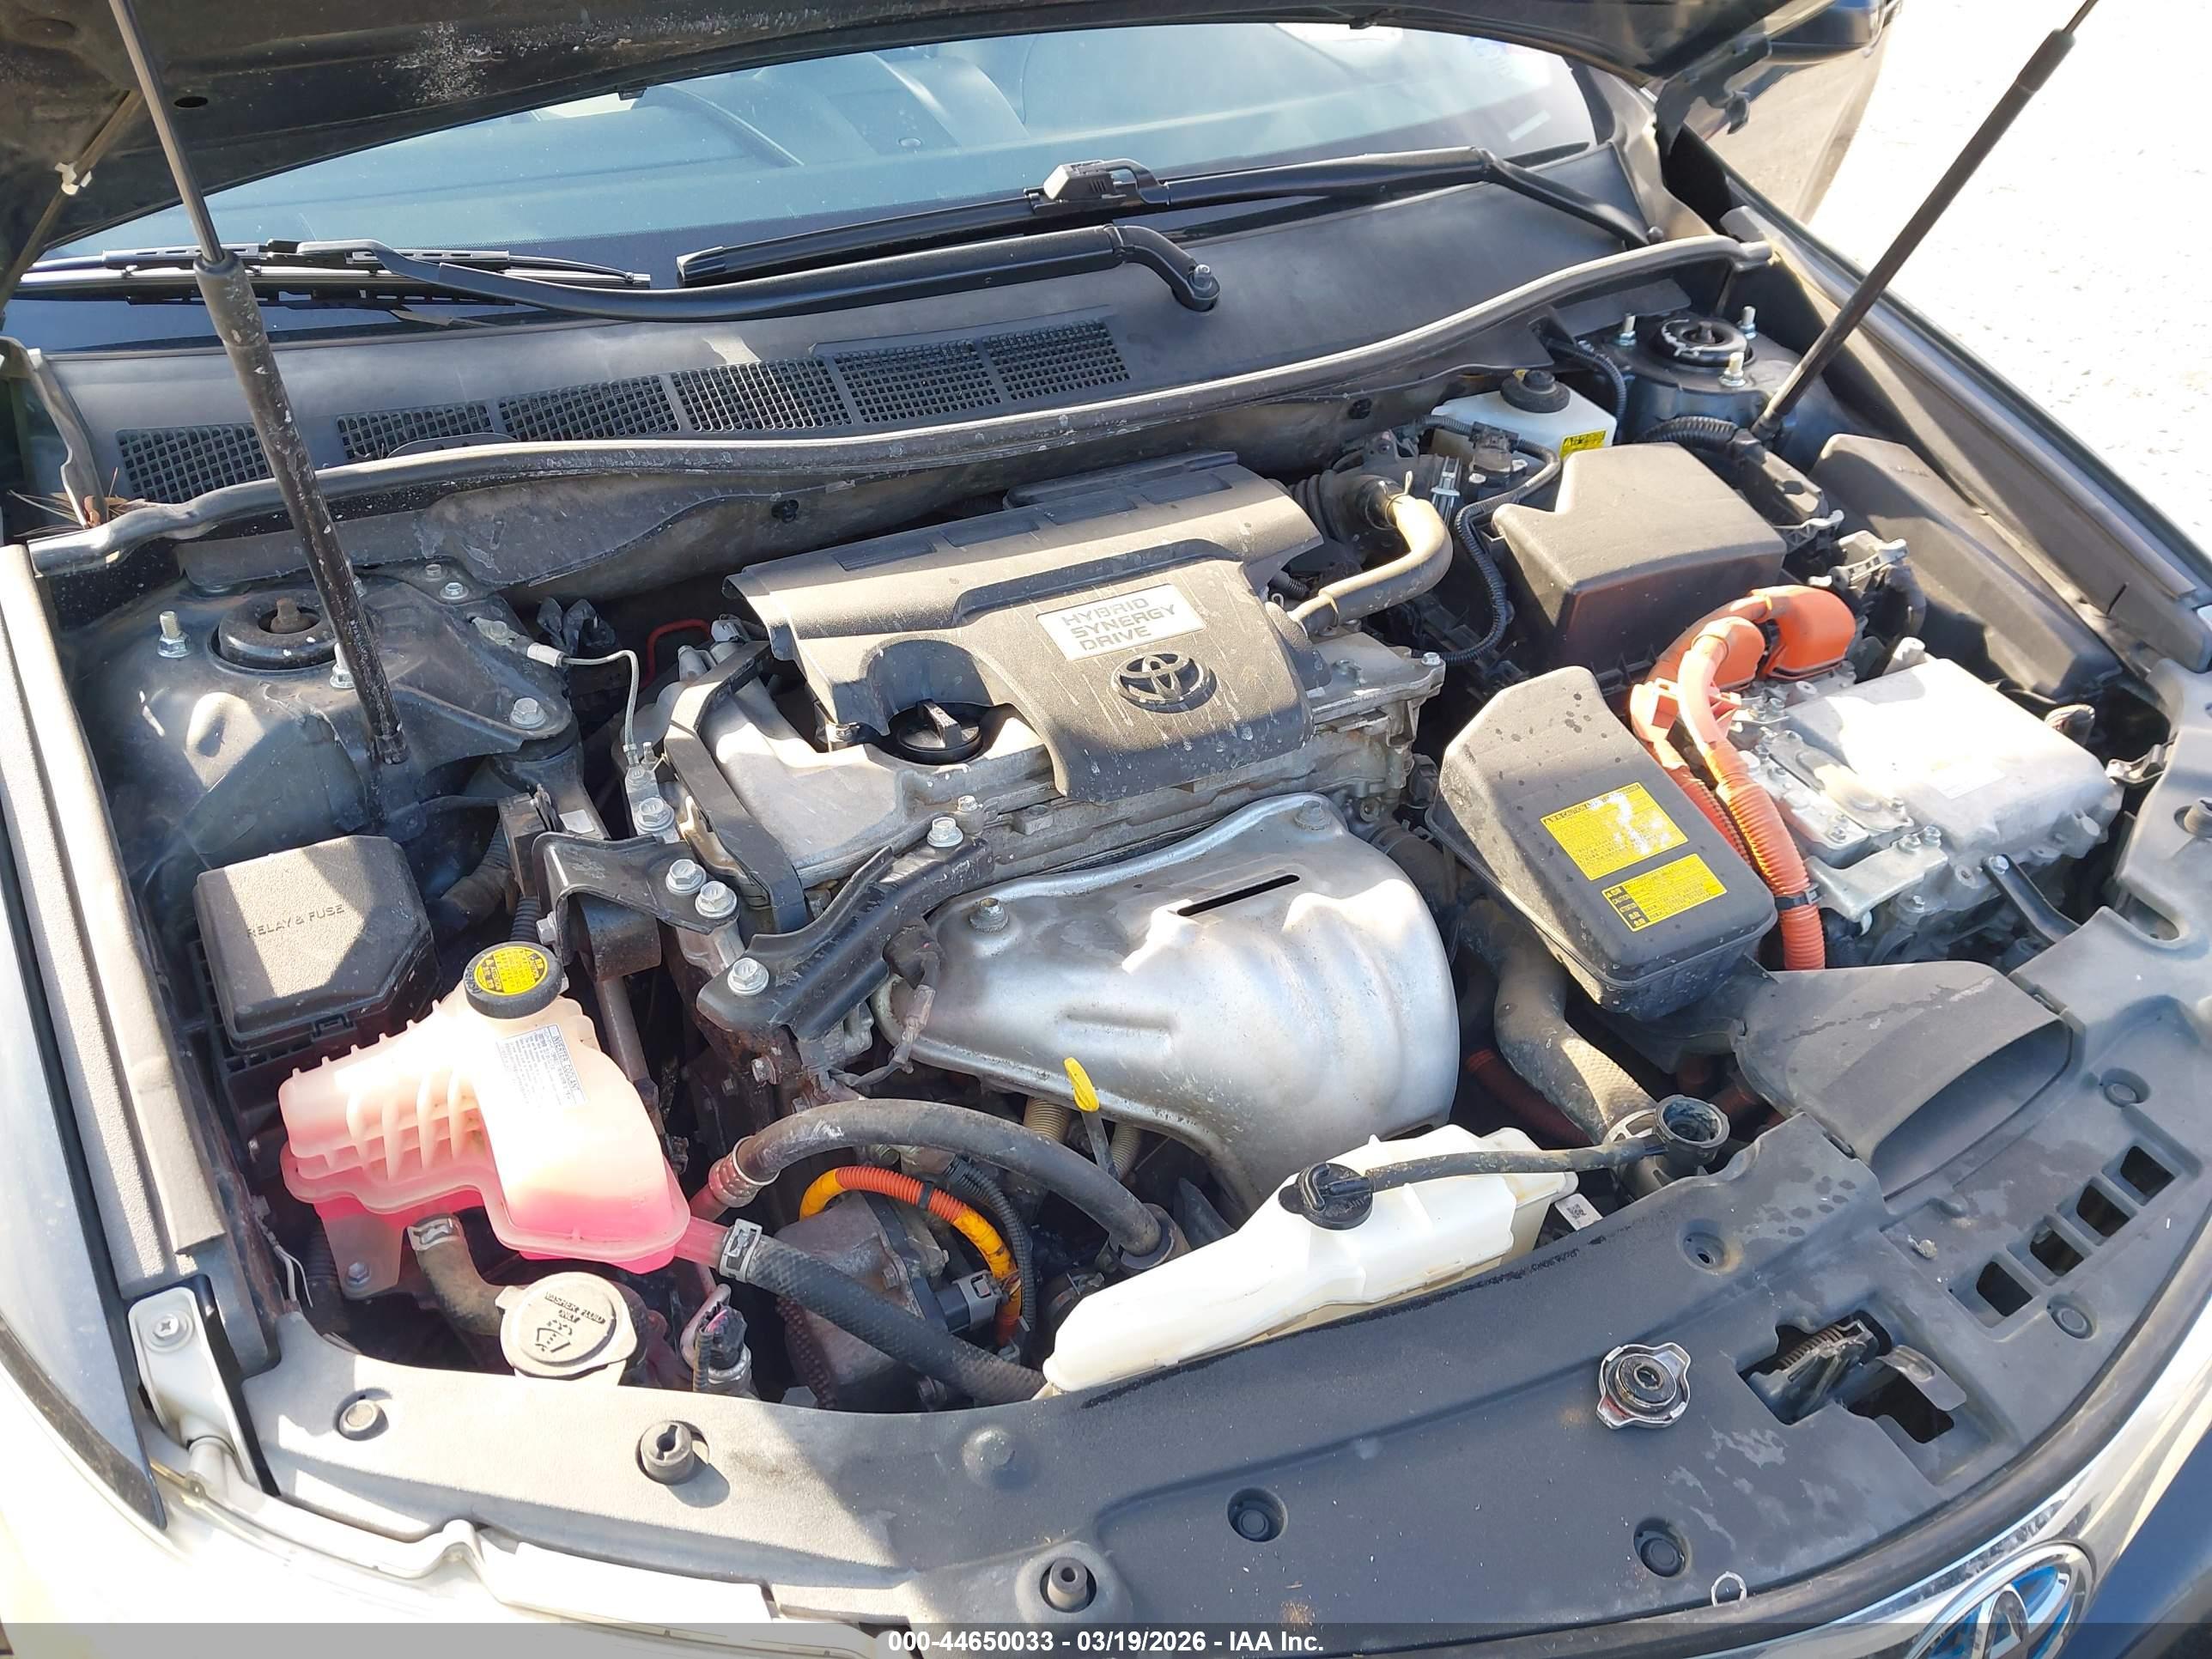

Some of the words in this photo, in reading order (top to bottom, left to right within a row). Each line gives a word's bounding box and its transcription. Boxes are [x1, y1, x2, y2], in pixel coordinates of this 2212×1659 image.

[1061, 598, 1150, 626] HYBRID
[1070, 604, 1176, 639] SYNERGY
[1079, 625, 1152, 651] DRIVE
[246, 916, 291, 938] RELAY
[295, 915, 305, 925] &
[308, 903, 344, 921] FUSE
[552, 1036, 568, 1061] INVERTER
[563, 1064, 580, 1091] COOLANT
